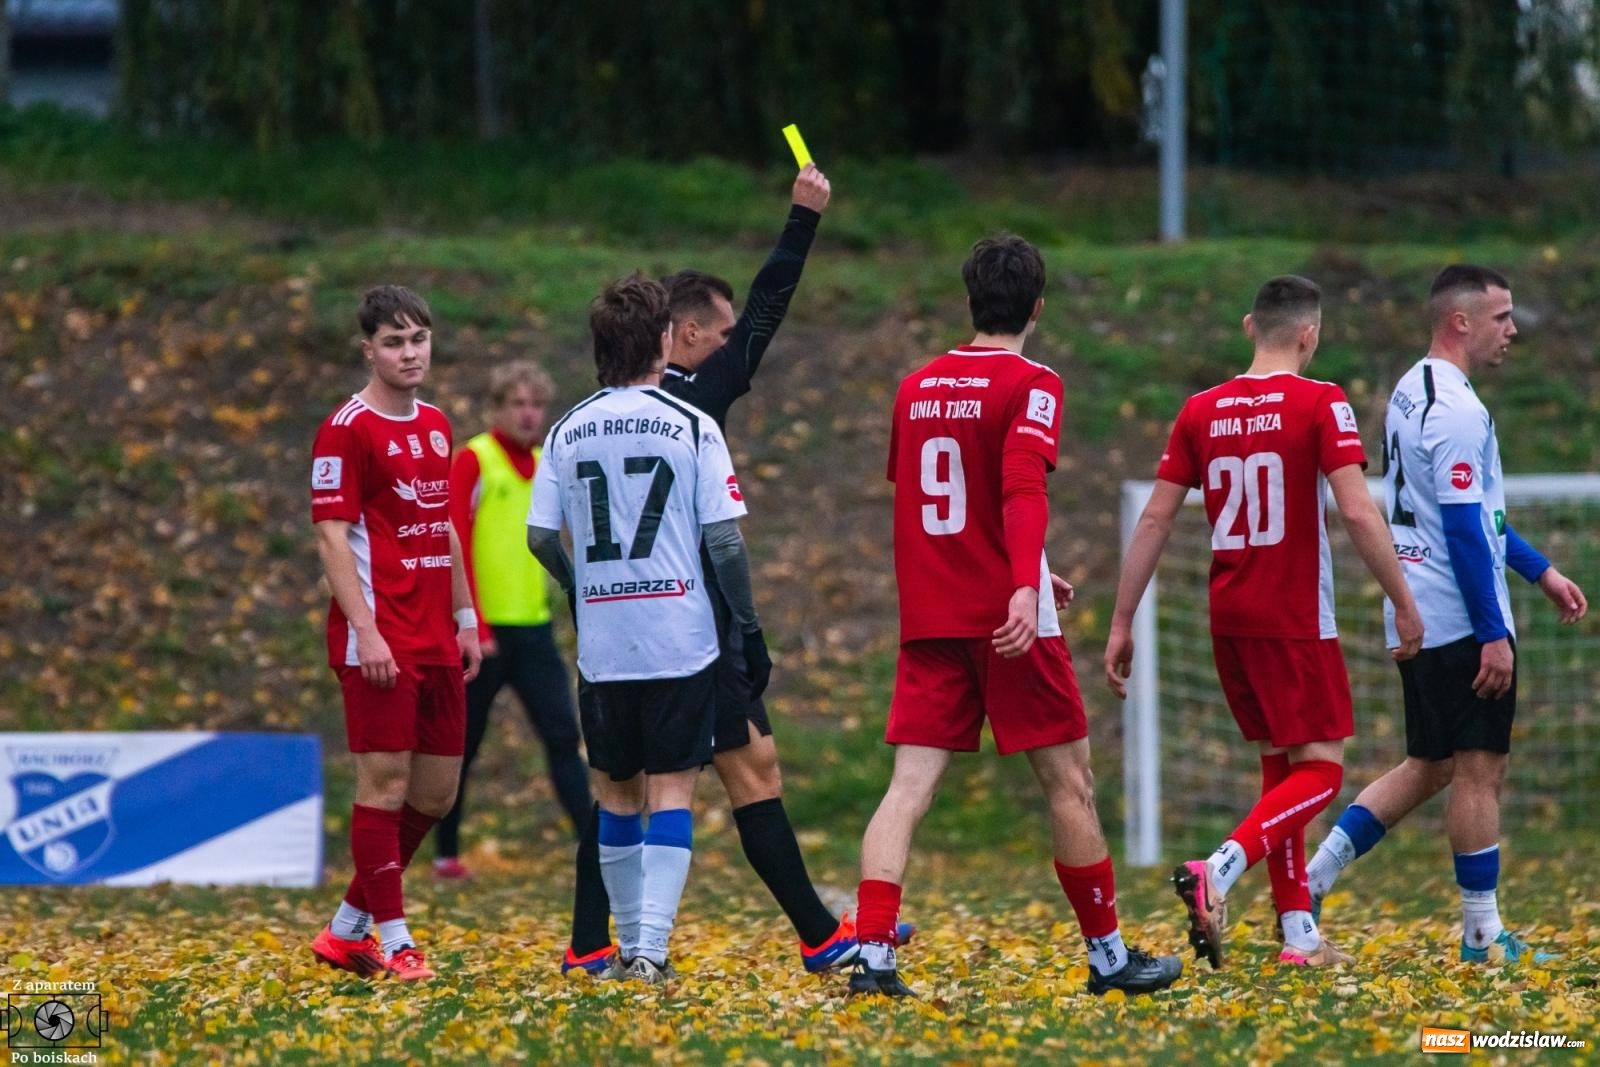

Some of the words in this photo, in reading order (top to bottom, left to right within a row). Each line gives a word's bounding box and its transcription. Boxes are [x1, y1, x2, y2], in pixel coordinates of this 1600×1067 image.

[909, 400, 941, 420] UNIA
[919, 377, 991, 389] GROS
[564, 421, 597, 445] UNIA
[603, 416, 684, 441] RACIBÓRZ
[1209, 417, 1243, 438] UNIA
[920, 437, 967, 536] 9
[1208, 451, 1285, 551] 20
[1382, 424, 1417, 529] 2
[576, 455, 676, 563] 17
